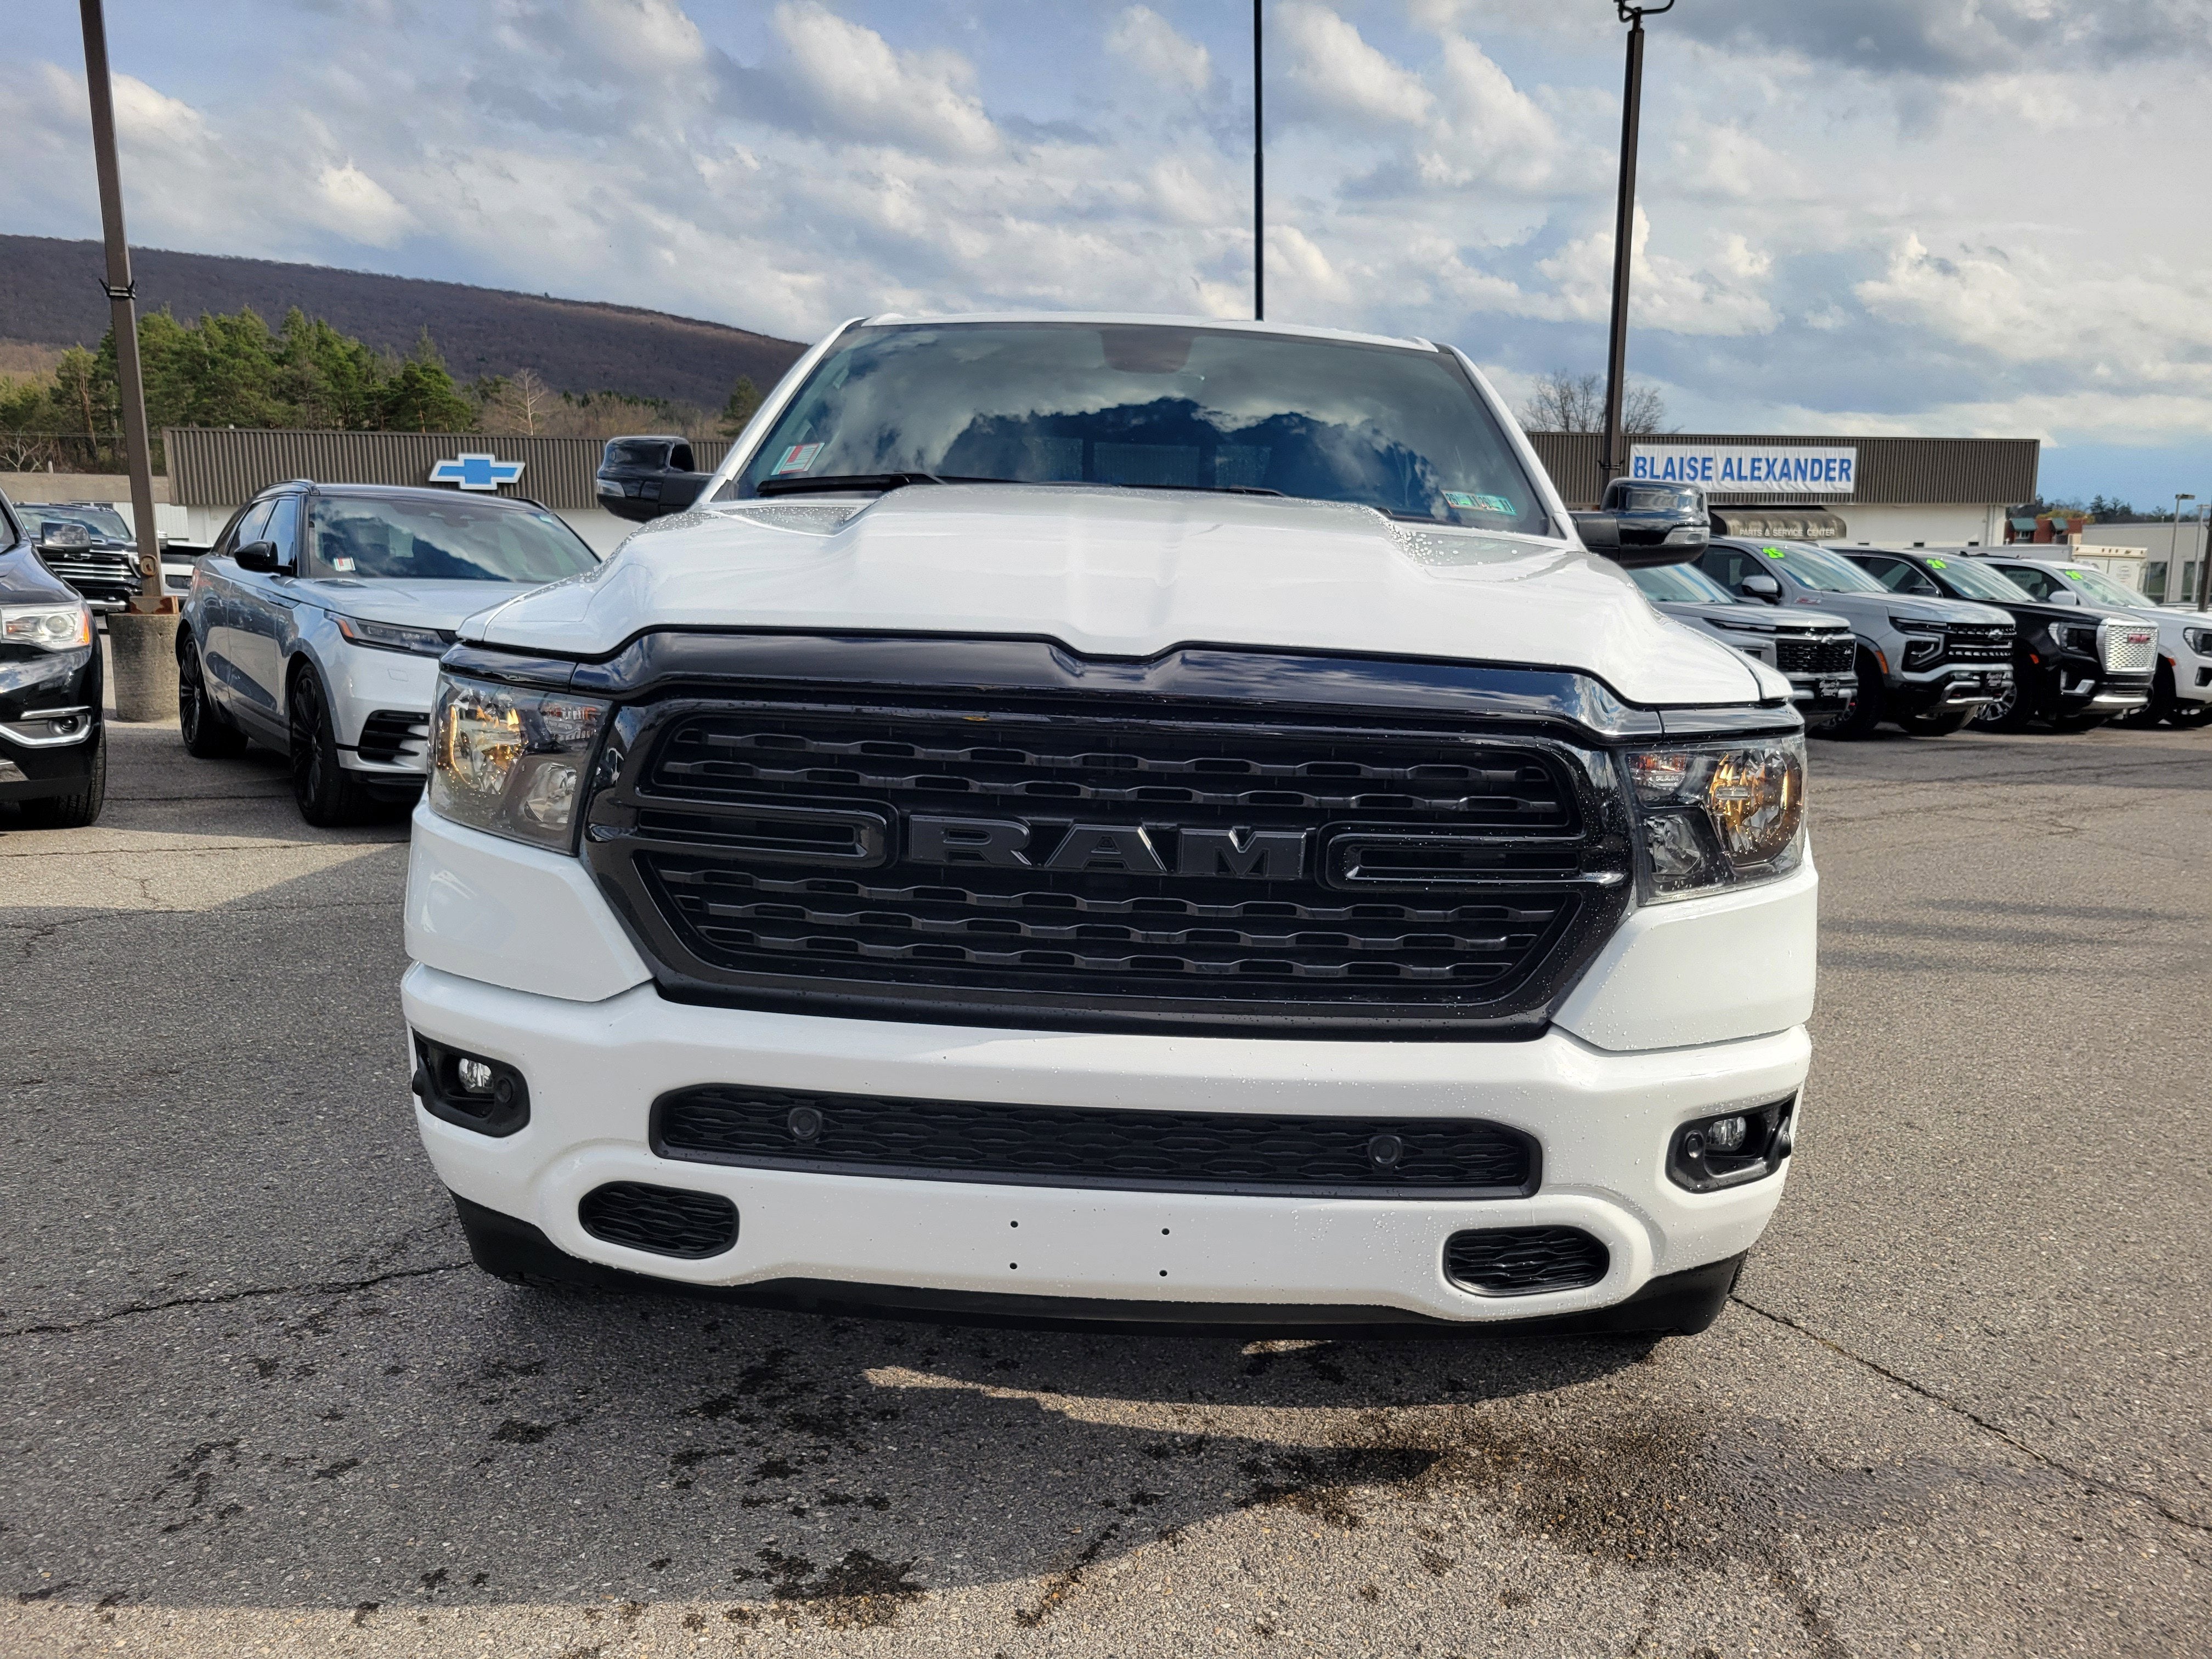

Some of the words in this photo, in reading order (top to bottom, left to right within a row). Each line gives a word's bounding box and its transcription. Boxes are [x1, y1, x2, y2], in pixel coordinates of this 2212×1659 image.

[1633, 456, 1713, 481] BLAISE
[1720, 457, 1852, 482] ALEXANDER
[1740, 528, 1763, 537] PARTS
[1764, 528, 1770, 537] &
[1773, 528, 1803, 537] SERVICE
[1807, 528, 1835, 537] CENTER
[909, 815, 1308, 879] RAM
